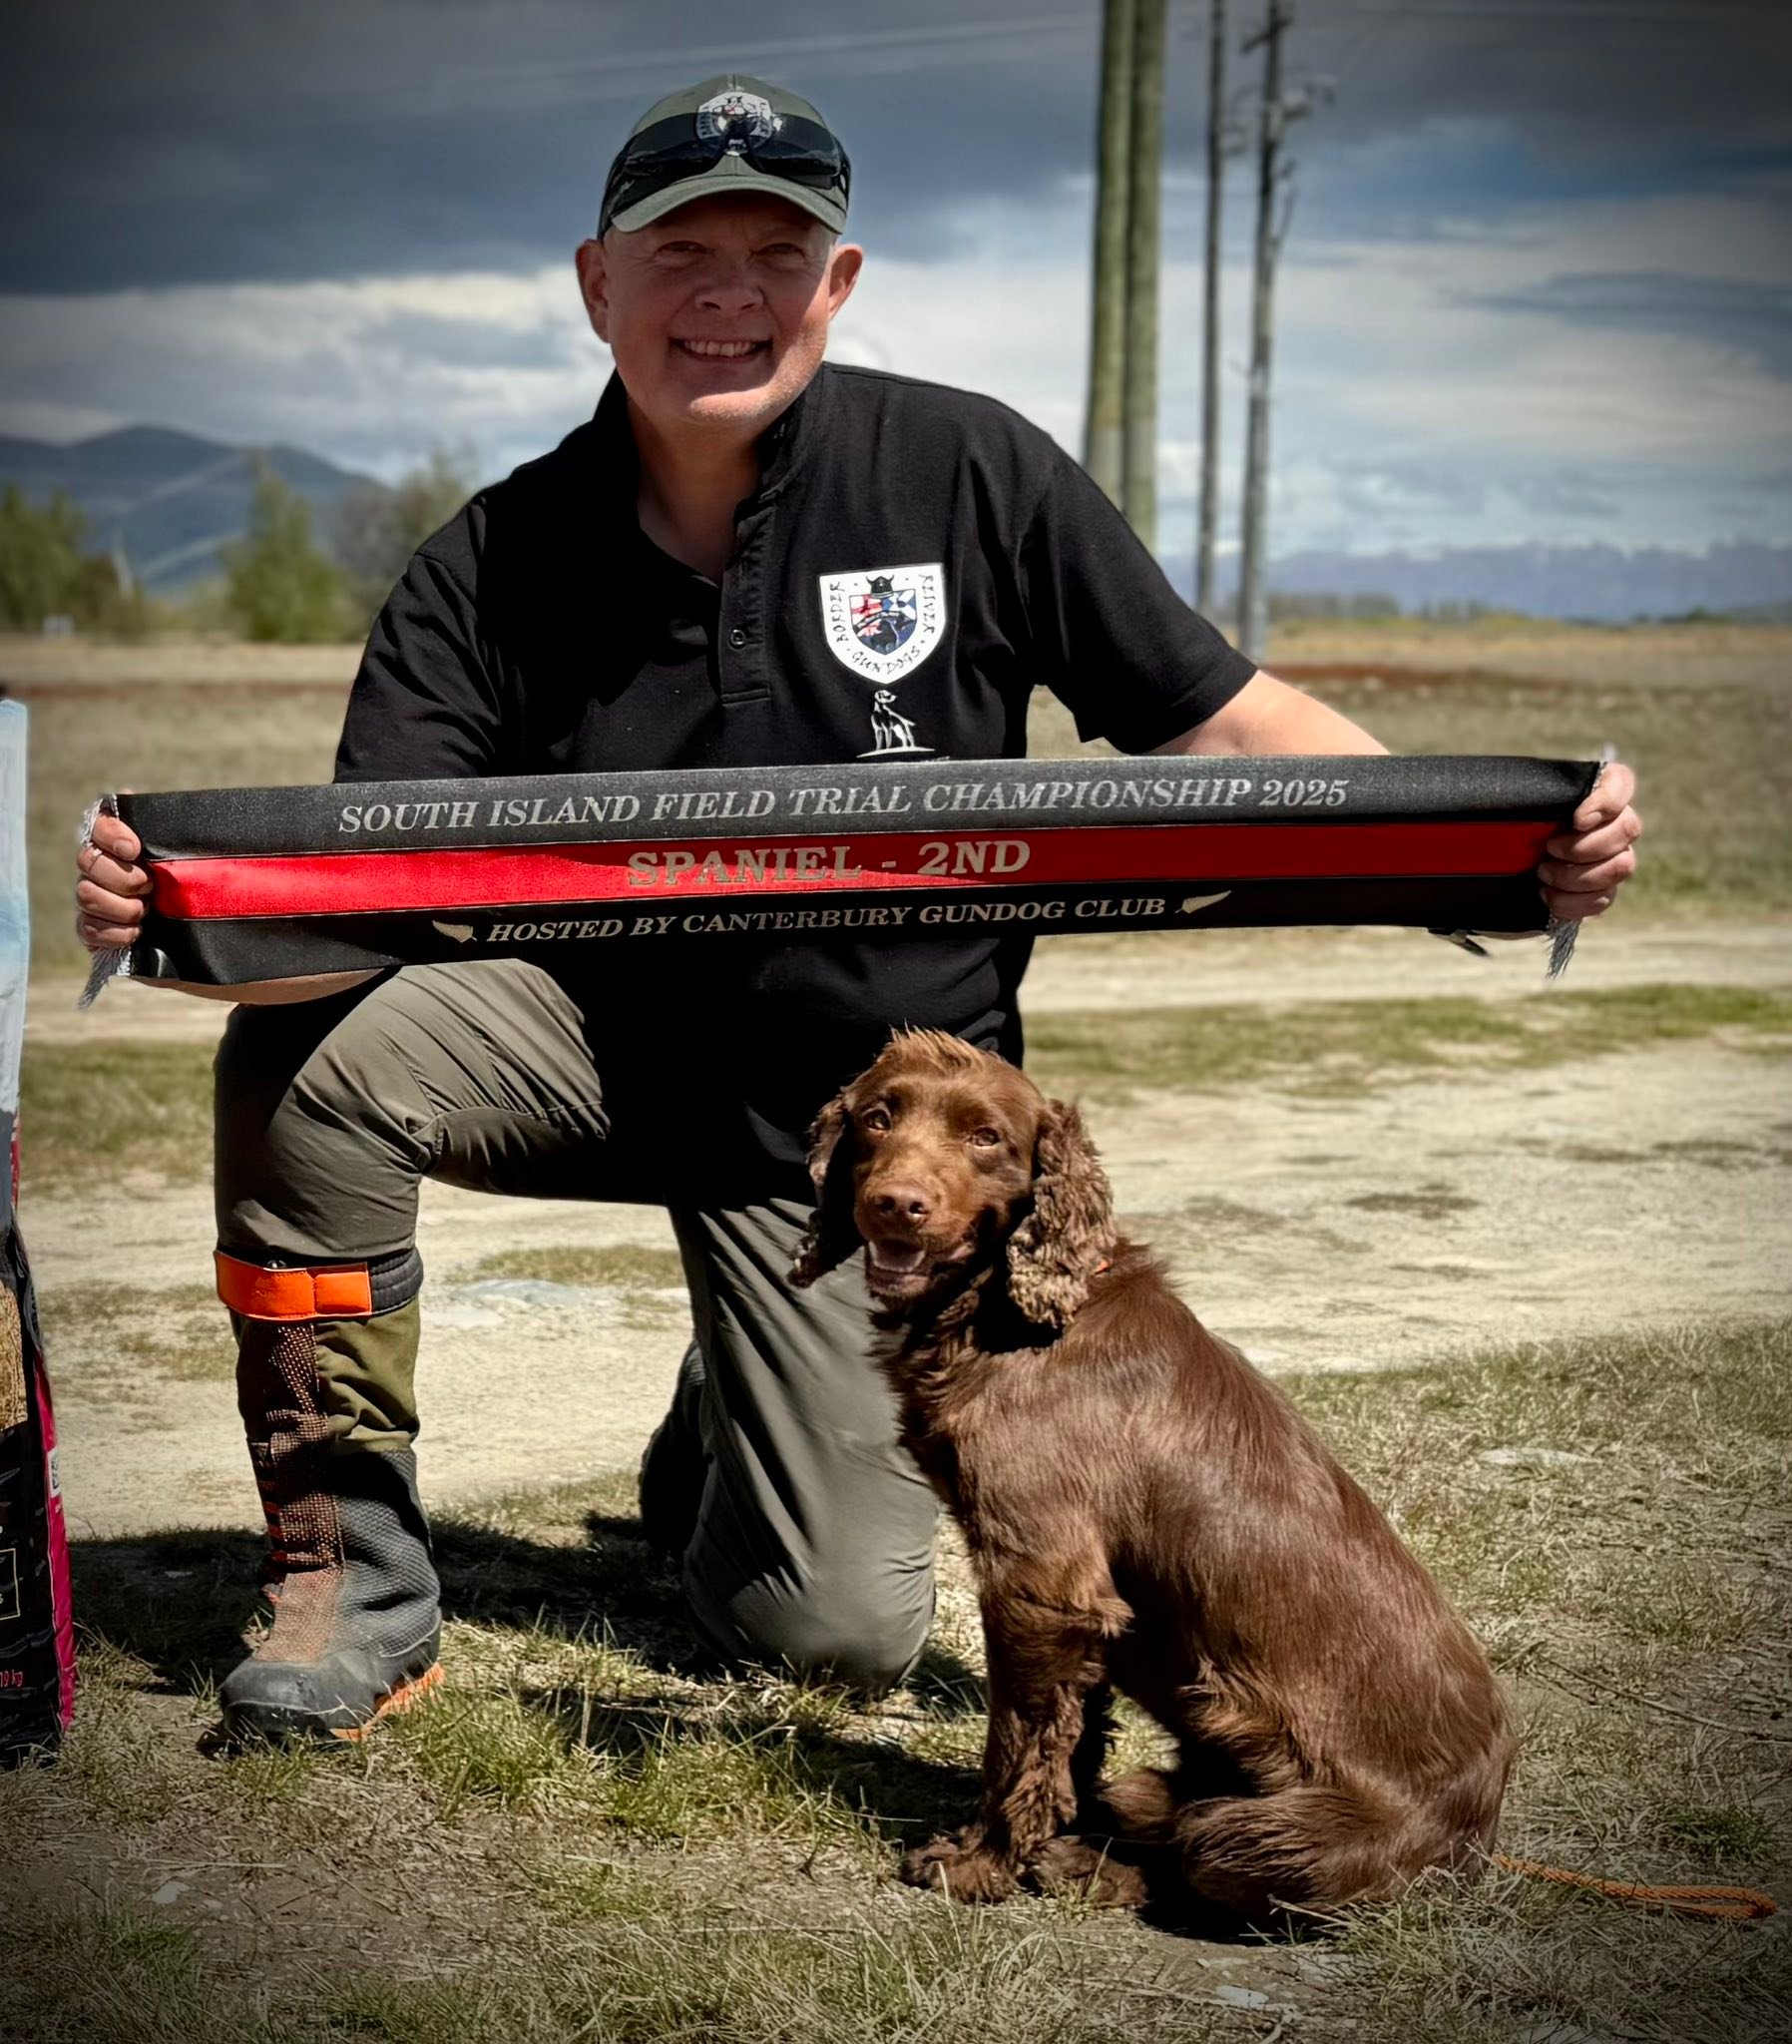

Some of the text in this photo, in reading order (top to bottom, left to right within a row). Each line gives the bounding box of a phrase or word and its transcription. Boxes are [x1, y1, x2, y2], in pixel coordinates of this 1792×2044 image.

[830, 581, 849, 643] BORDER
[852, 645, 921, 675] GUNDOGS
[339, 778, 1350, 832] SOUTH ISLAND FIELD TRIAL CHAMPIONSHIP 2025
[628, 845, 862, 885] SPANIEL
[918, 840, 1031, 875] 2ND
[486, 898, 1165, 942] HOSTED BY CANTERBURY GUNDOG CLUB
